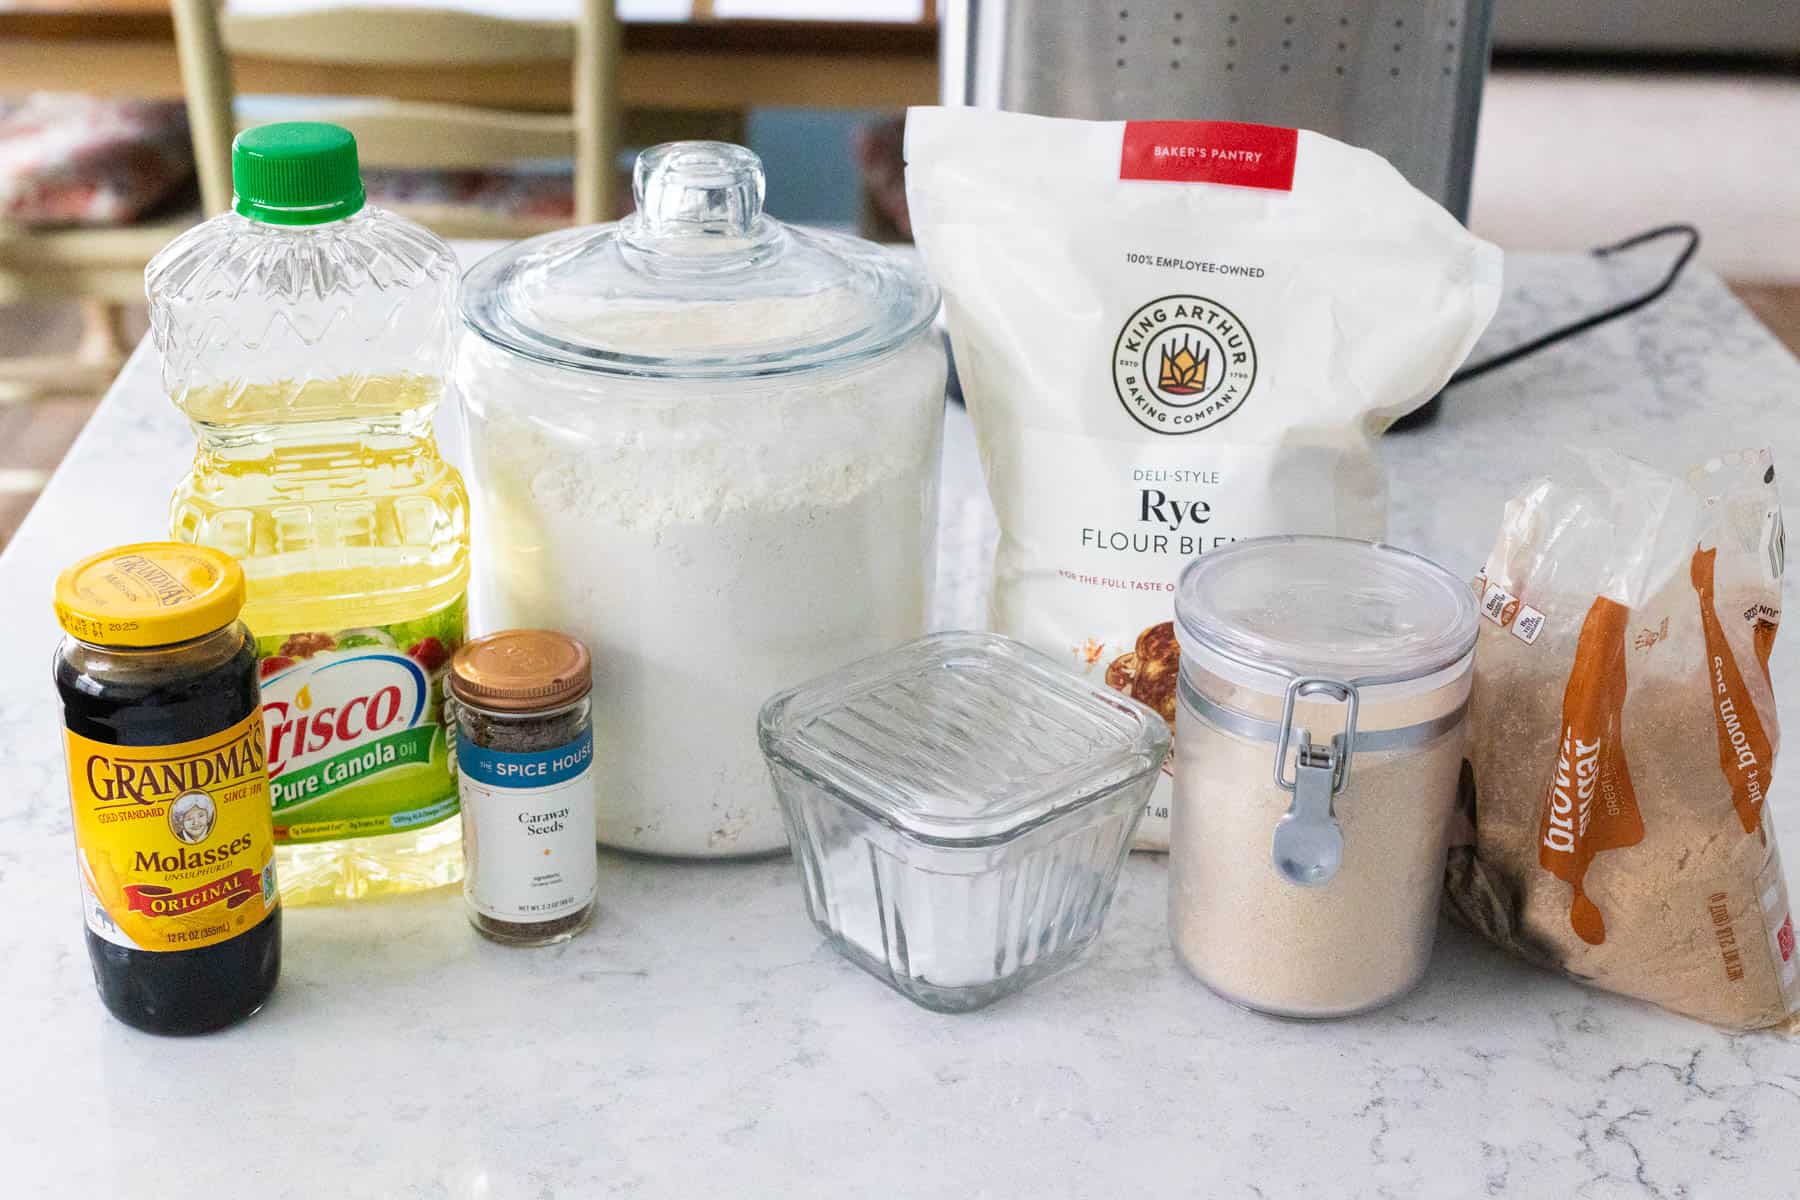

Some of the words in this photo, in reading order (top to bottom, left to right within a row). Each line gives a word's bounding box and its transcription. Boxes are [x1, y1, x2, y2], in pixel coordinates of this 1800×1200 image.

[1154, 145, 1207, 159] BAKER'S
[1211, 150, 1263, 163] PANTRY
[1126, 252, 1153, 265] 100%
[1156, 256, 1265, 278] EMPLOYEE-OWNED
[1125, 308, 1167, 353] KING
[1174, 304, 1247, 366] ARTHUR
[1125, 376, 1167, 423] BAKING
[1173, 385, 1238, 425] COMPANY
[1133, 469, 1220, 484] DELI-STYLE
[1138, 488, 1211, 531] Rye
[1082, 528, 1169, 554] FLOUR
[1180, 536, 1247, 555] BLE
[1079, 575, 1099, 586] THE
[1102, 578, 1126, 589] FULL
[1130, 581, 1163, 592] TASTE
[1165, 583, 1176, 592] O
[1720, 697, 1758, 770] brown
[87, 719, 265, 806] GRANDMA'S
[270, 775, 320, 806] Pure
[323, 743, 395, 785] Canola
[400, 741, 417, 757] Oil
[496, 762, 548, 776] SPICE
[552, 741, 592, 773] HOUSE
[223, 786, 247, 804] SINCE
[1748, 769, 1762, 803] ligt
[119, 807, 165, 823] STANDARD
[518, 807, 570, 825] Caraway
[527, 821, 564, 836] Seeds
[135, 832, 251, 873] Molasses
[150, 876, 242, 914] ORIGINAL
[168, 932, 177, 943] 12
